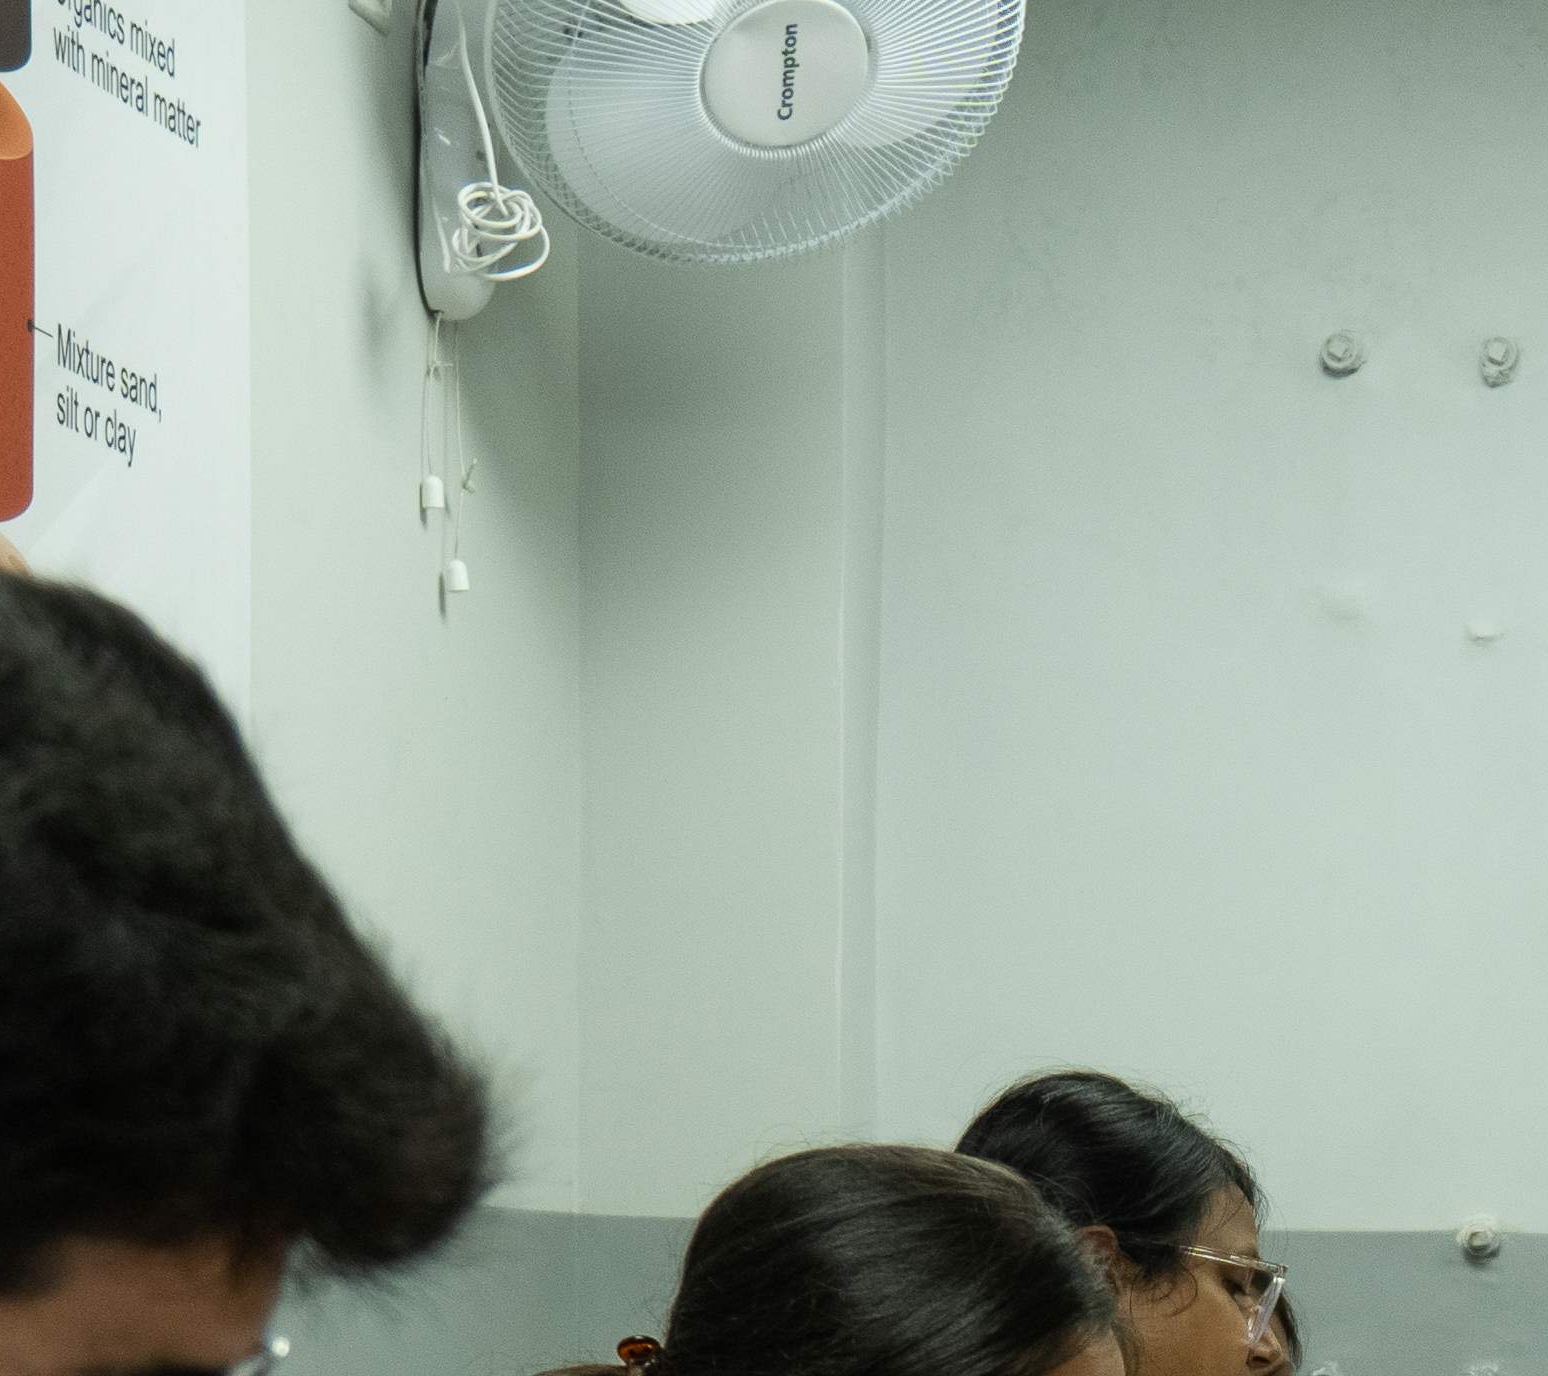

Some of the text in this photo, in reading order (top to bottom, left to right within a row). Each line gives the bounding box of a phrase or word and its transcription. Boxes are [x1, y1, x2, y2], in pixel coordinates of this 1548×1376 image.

[53, 25, 201, 148] with mineral matter
[57, 0, 176, 78] ganics mixed
[777, 23, 800, 121] Crompton
[57, 323, 162, 423] Mixture sand,
[56, 385, 137, 468] silt or clay
